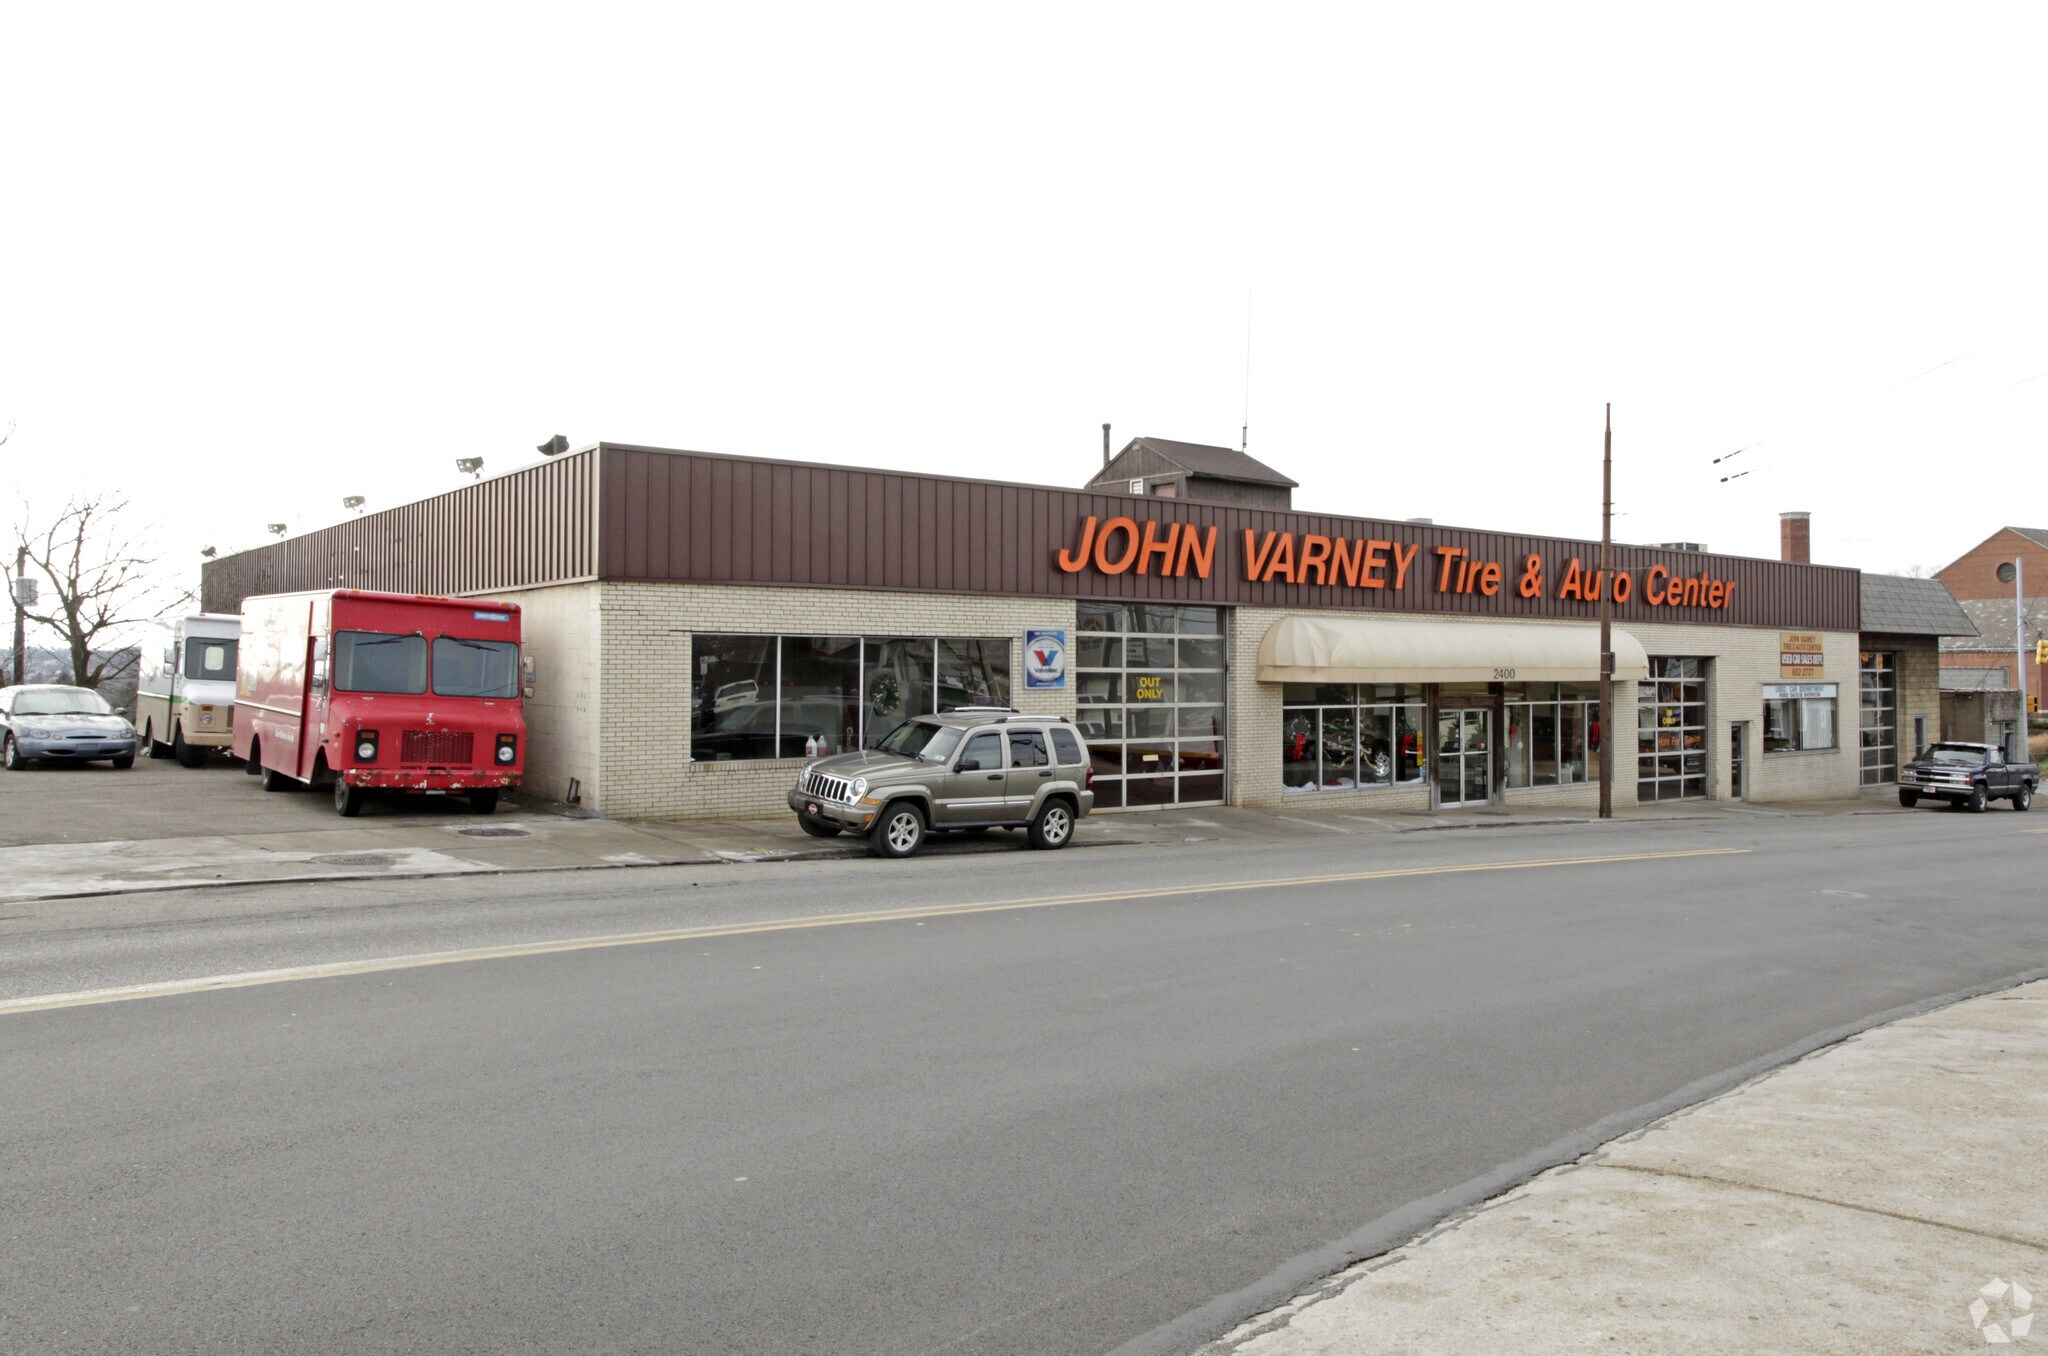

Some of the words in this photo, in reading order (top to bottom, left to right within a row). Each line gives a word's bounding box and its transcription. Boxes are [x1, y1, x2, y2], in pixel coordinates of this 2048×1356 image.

[1058, 515, 1218, 579] JOHN
[1243, 528, 1419, 590] VARNEY
[1436, 545, 1502, 597] Tire
[1518, 553, 1542, 598] &
[1559, 557, 1632, 603] Auo
[1646, 563, 1735, 609] Center
[1493, 668, 1516, 680] 2400
[1140, 677, 1161, 688] OUT
[1136, 688, 1164, 699] ONLY
